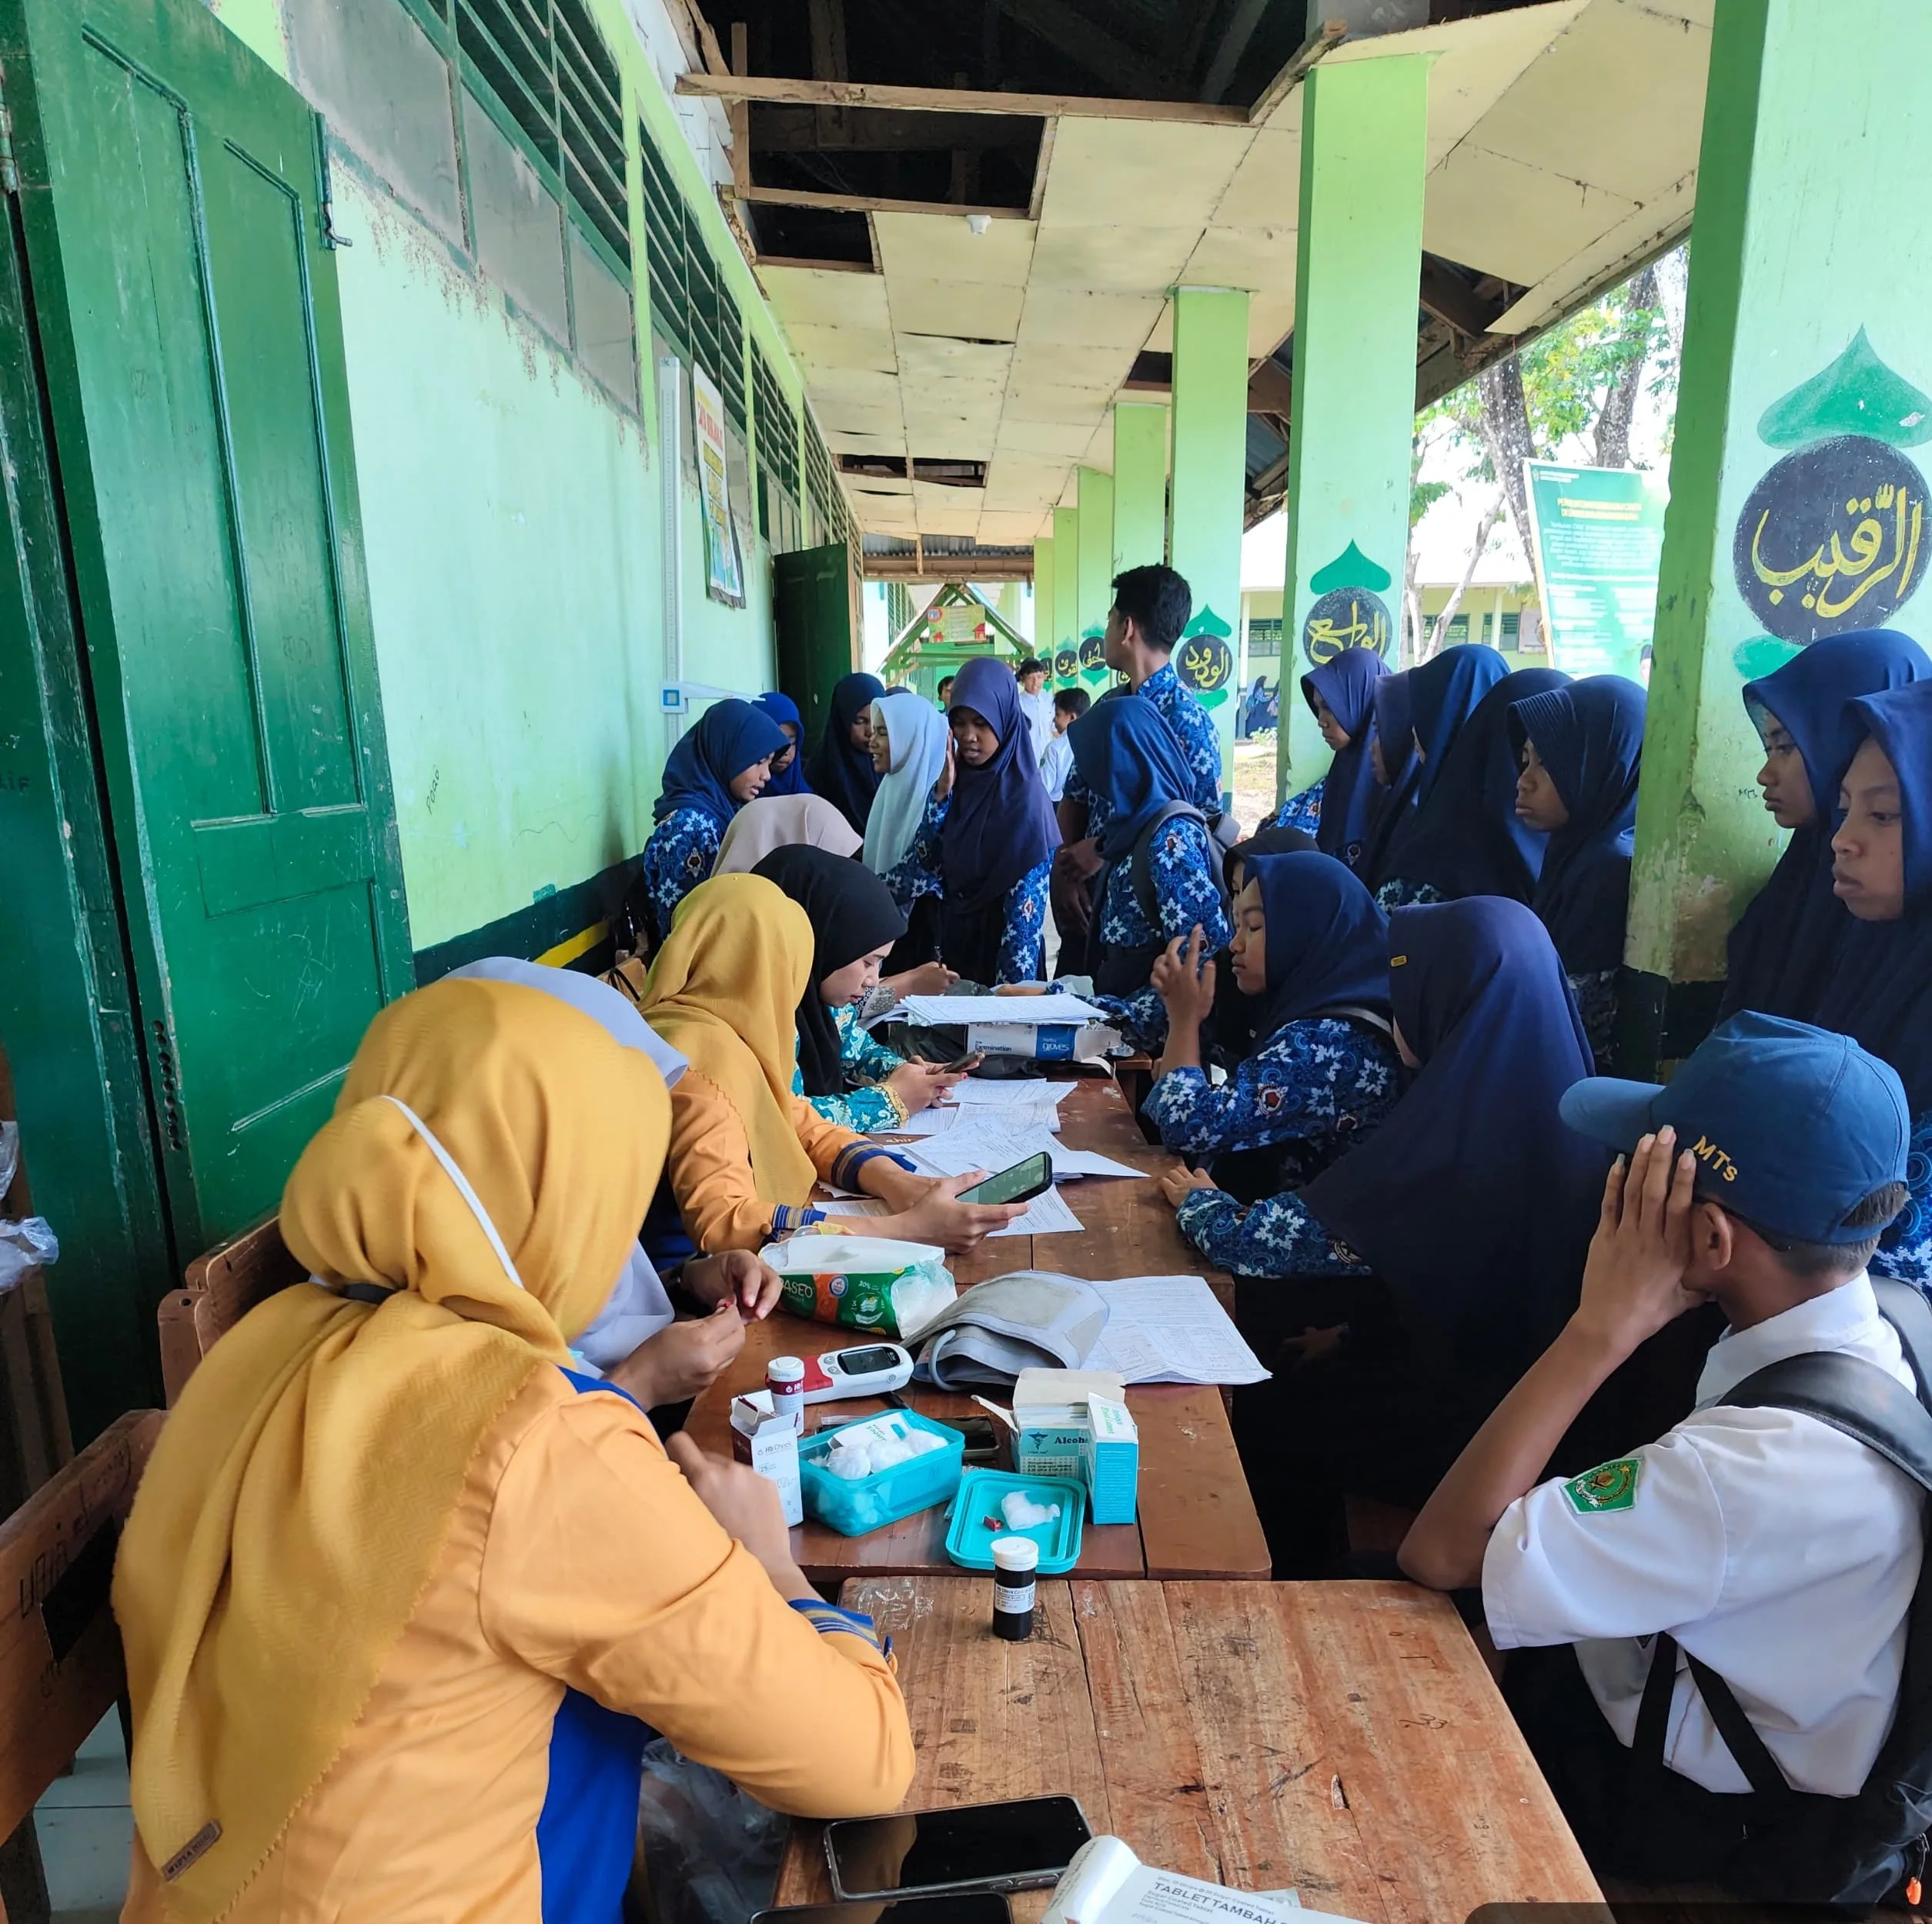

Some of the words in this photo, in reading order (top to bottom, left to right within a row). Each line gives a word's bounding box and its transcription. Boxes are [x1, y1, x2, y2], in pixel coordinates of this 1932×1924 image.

[1692, 1134, 1738, 1182] MTs
[781, 1279, 813, 1298] ASEO
[1054, 1436, 1089, 1445] Alcoh
[1155, 1882, 1212, 1904] TABLET
